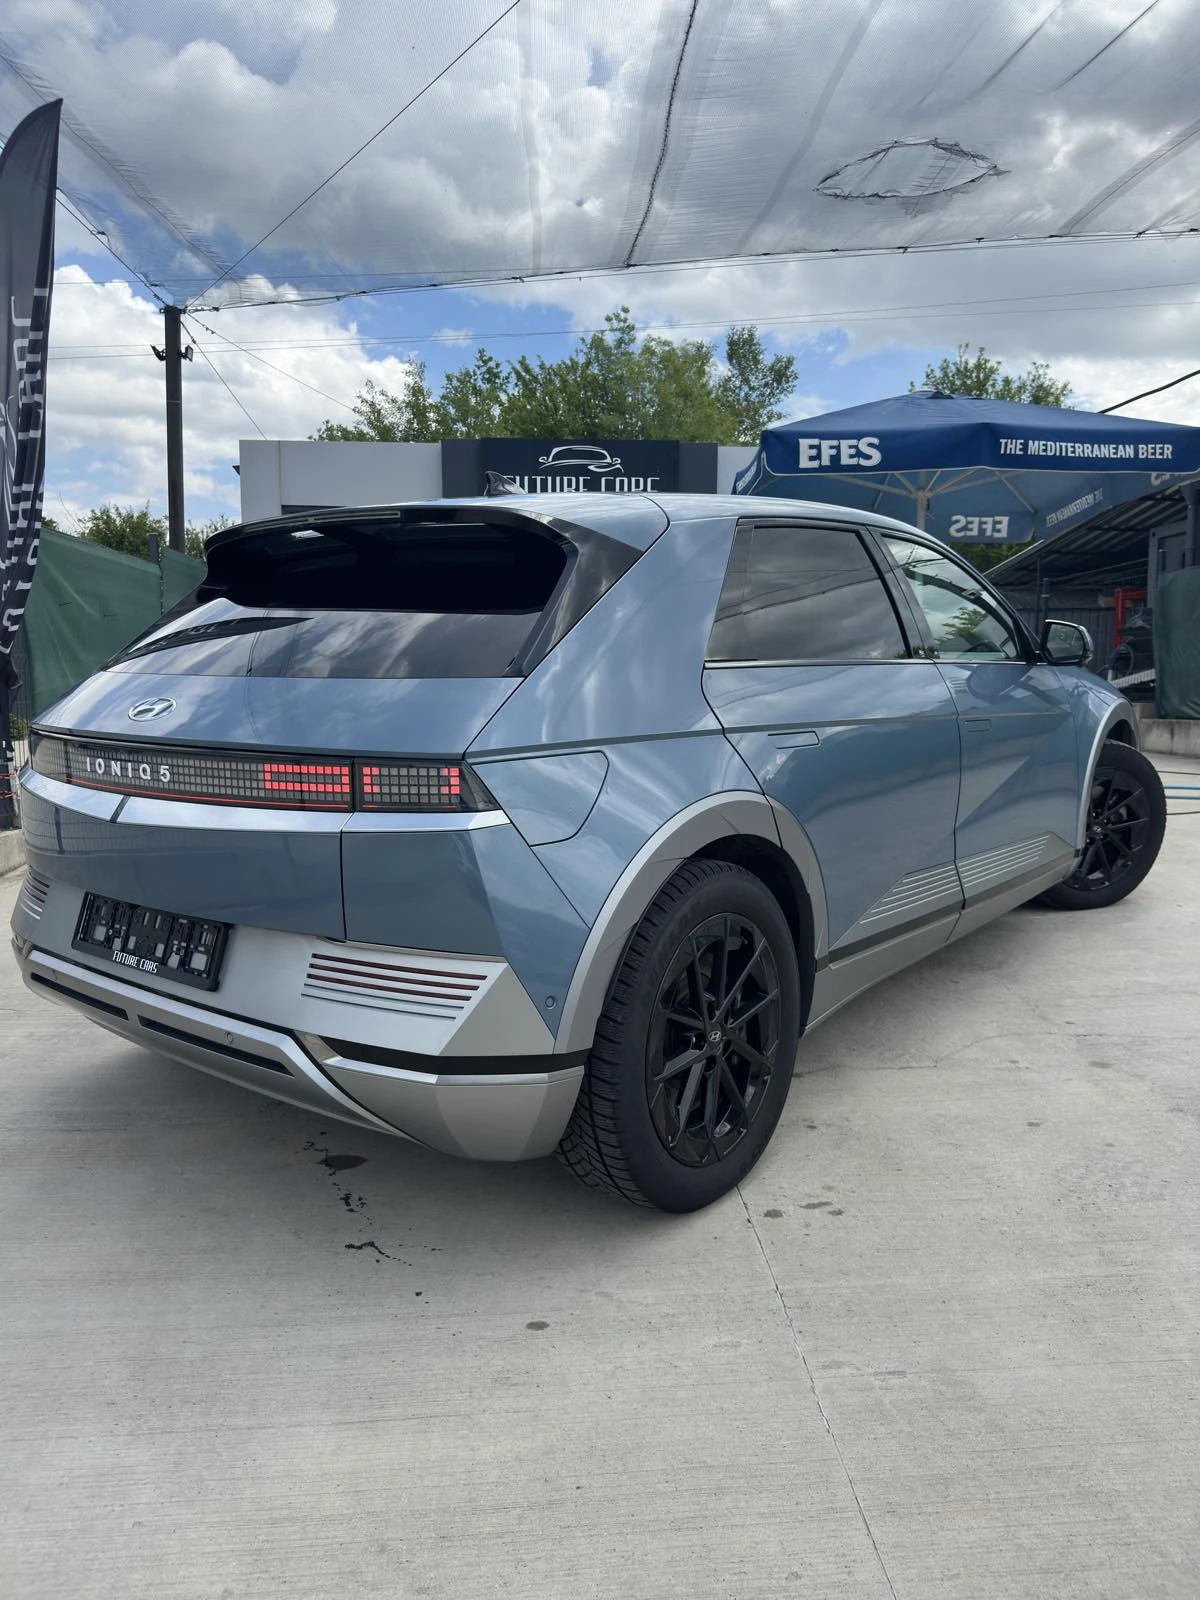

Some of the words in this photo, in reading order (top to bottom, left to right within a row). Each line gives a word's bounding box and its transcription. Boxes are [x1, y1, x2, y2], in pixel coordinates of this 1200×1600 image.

[798, 436, 882, 469] EFES
[999, 438, 1025, 455] THE
[1027, 440, 1135, 459] MEDITERRANEAN
[1138, 444, 1173, 459] BEER
[86, 757, 152, 781] IONIQ
[160, 765, 171, 783] 5
[112, 950, 140, 968] FUTURE
[139, 958, 159, 974] CARS
